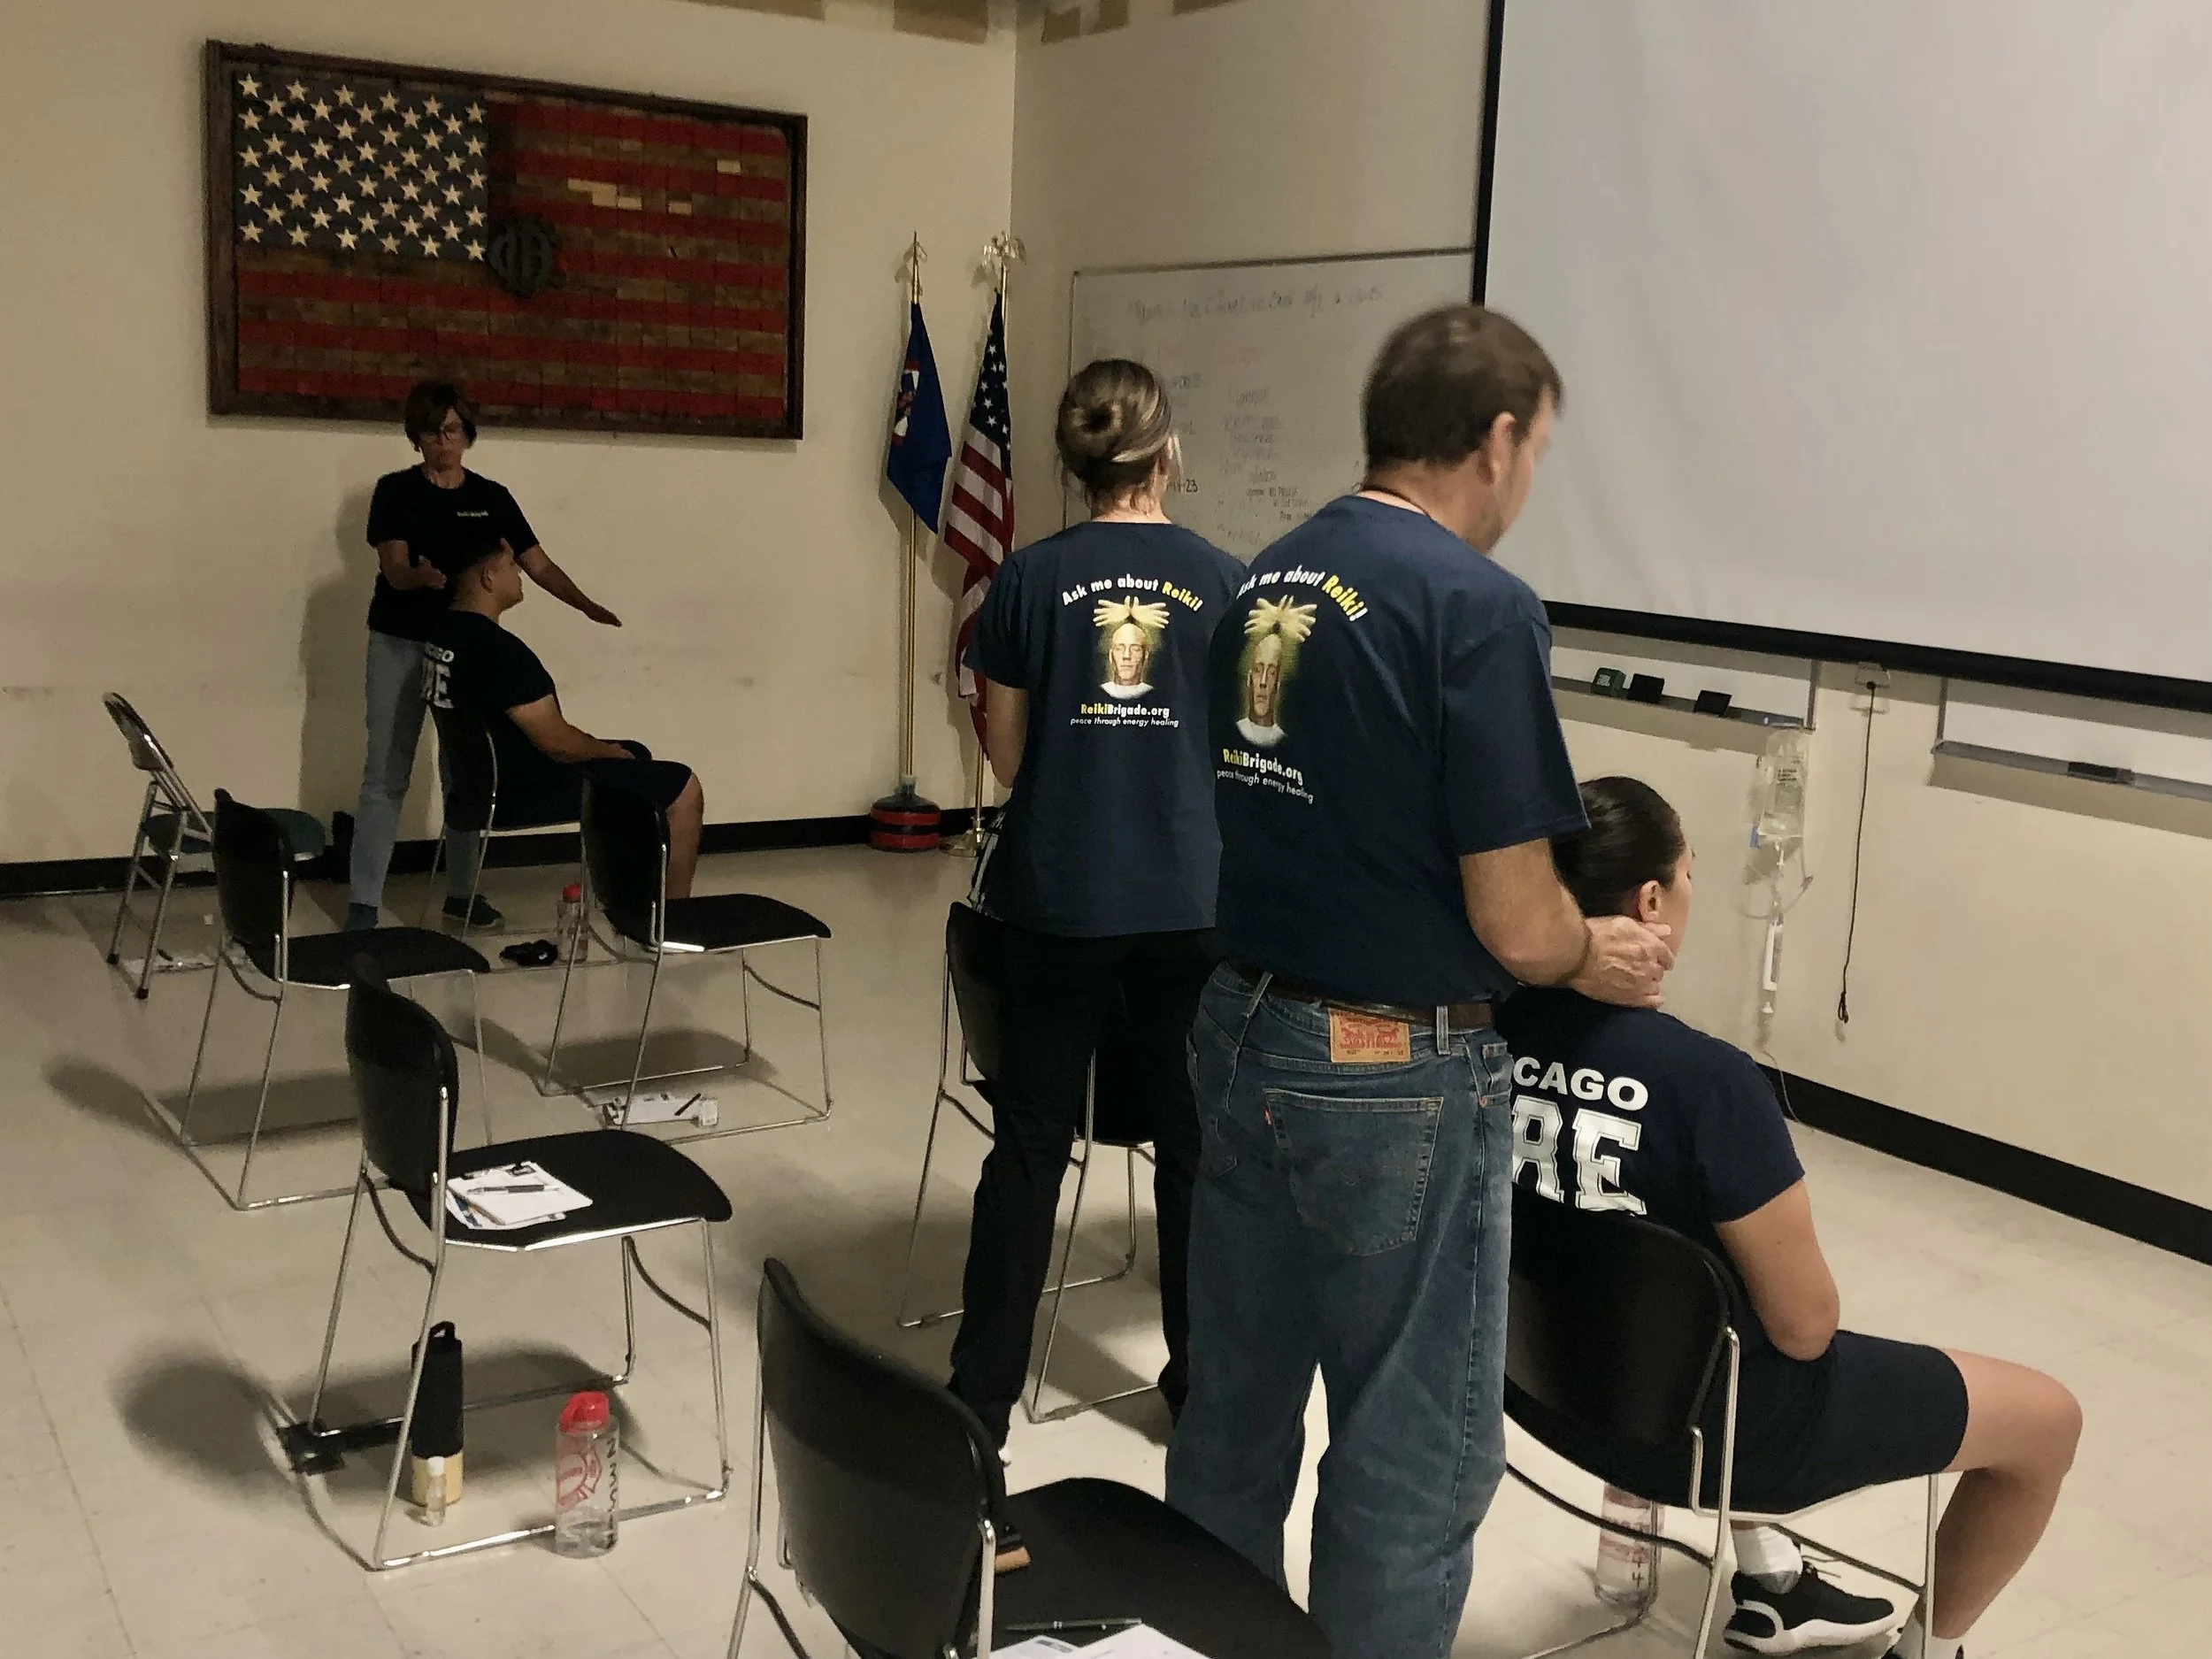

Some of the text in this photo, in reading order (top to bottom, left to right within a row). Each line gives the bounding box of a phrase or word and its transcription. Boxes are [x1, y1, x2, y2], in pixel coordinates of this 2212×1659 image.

[1062, 573, 1203, 611] Ask me about Reiki!
[1258, 571, 1282, 587] me
[1283, 564, 1326, 587] about
[1321, 574, 1369, 622] Reiki!
[1070, 717, 1179, 728] peace through energy healing
[1080, 703, 1171, 718] ReikiBrigade.org
[1511, 1094, 1647, 1217] RE
